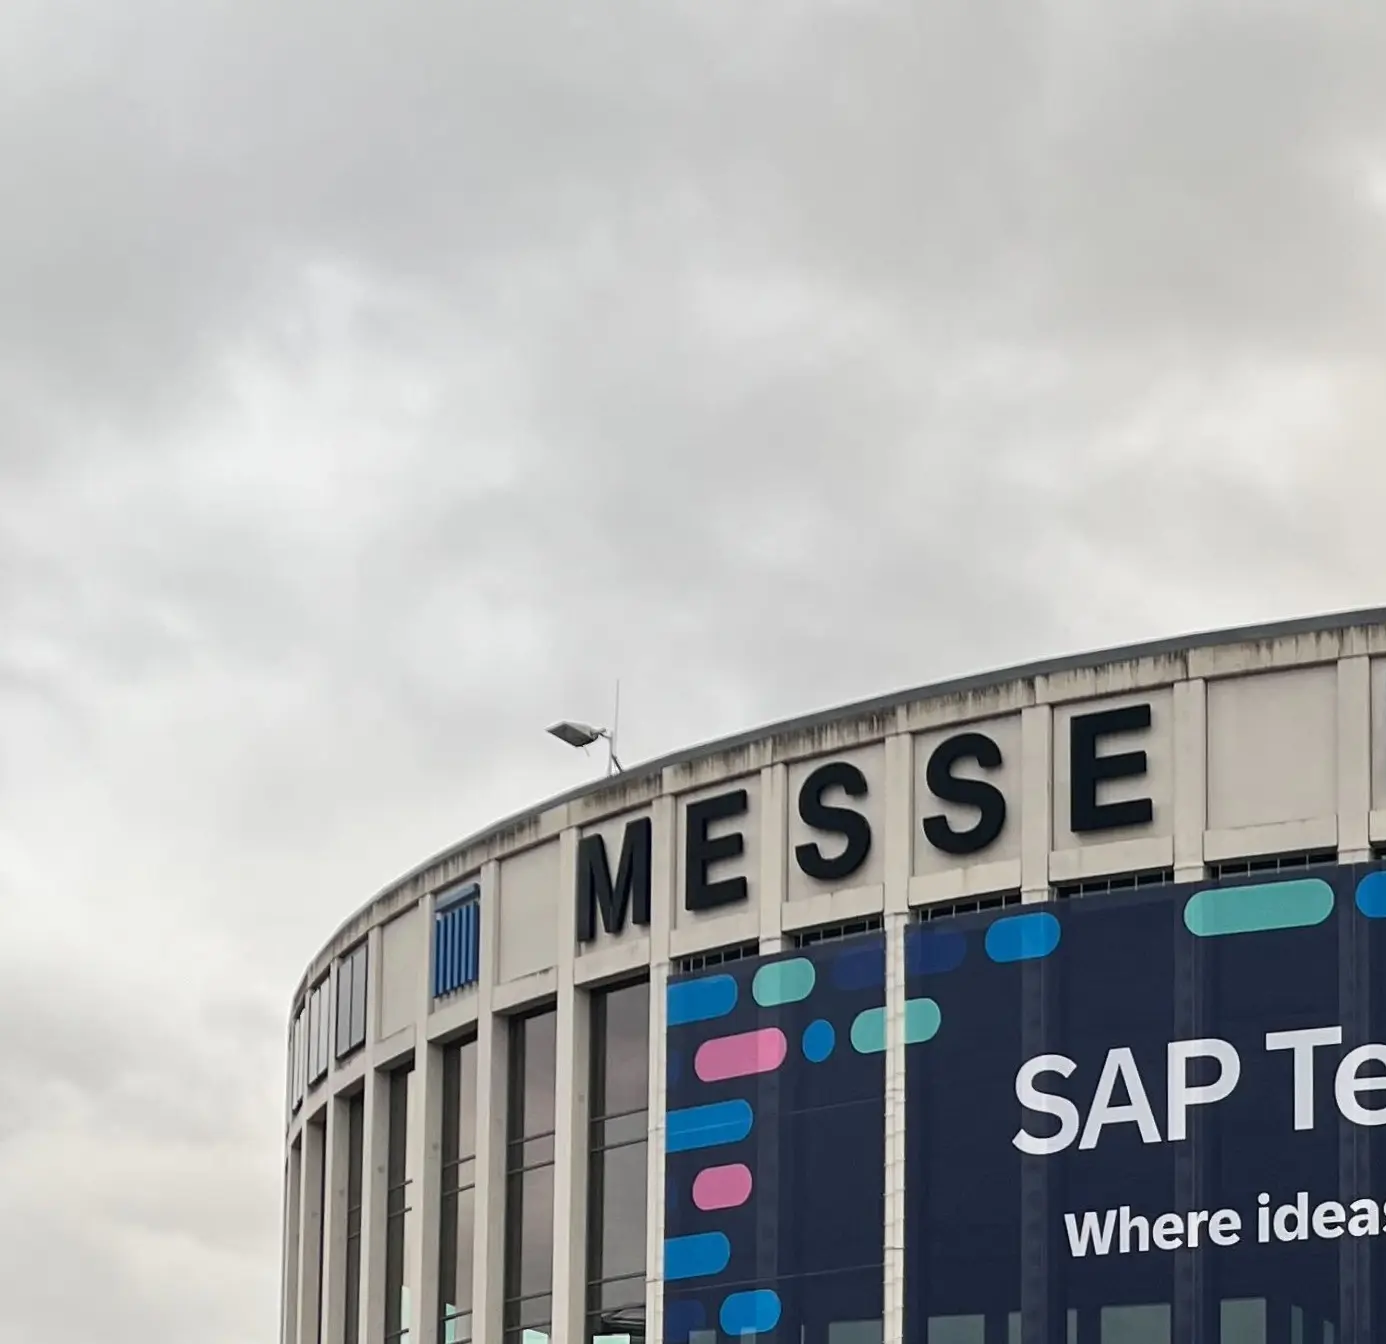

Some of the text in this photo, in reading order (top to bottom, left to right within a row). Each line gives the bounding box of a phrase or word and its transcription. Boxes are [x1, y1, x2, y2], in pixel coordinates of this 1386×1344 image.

[576, 704, 1154, 942] MESSE
[1012, 1038, 1241, 1155] SAP
[1064, 1205, 1242, 1257] Where
